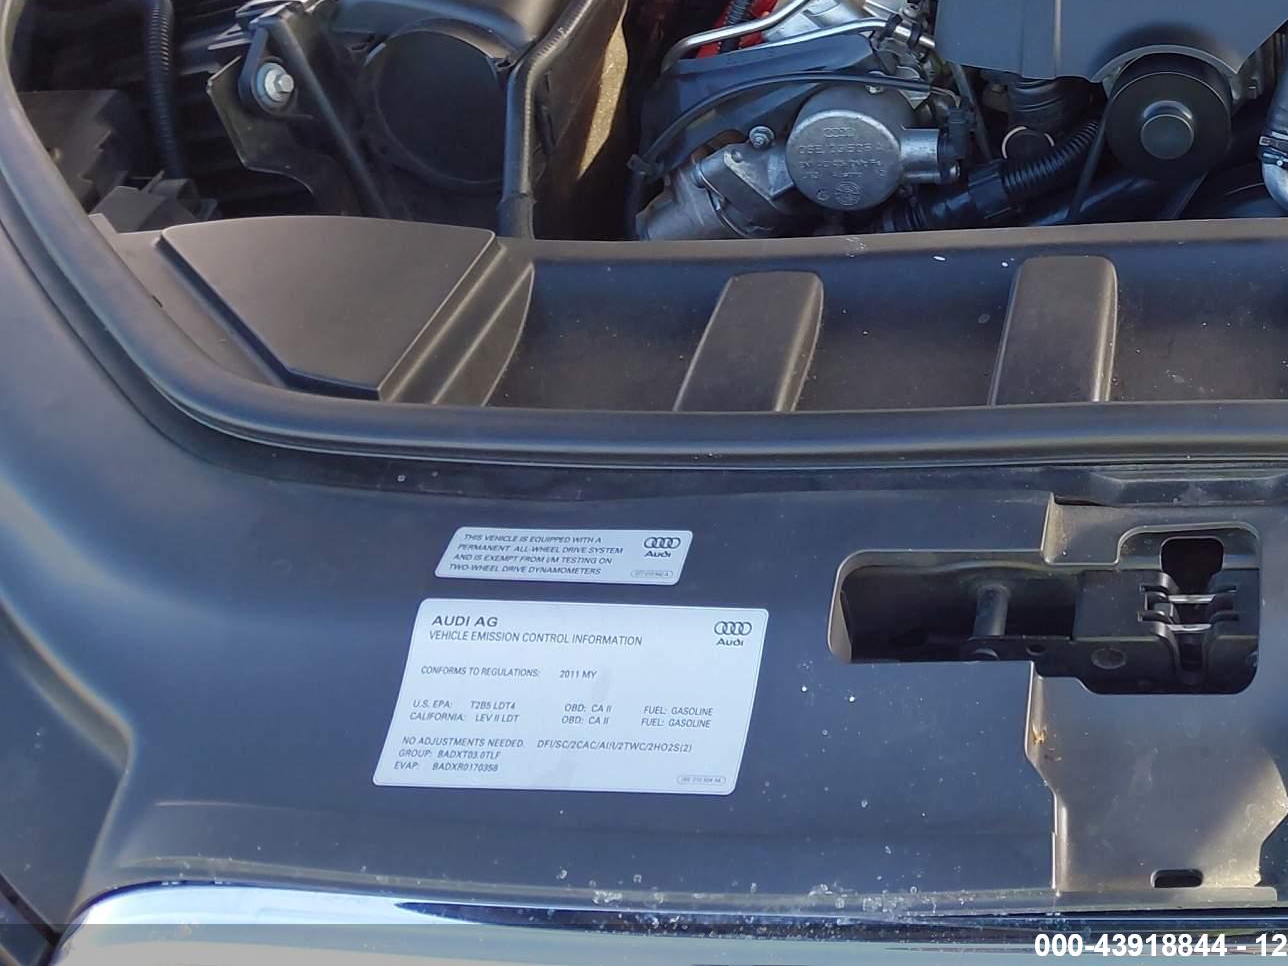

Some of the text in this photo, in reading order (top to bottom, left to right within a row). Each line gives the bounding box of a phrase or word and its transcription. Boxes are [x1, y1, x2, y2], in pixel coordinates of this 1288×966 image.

[485, 534, 517, 542] VEHICLE
[458, 544, 510, 552] PERMANENT
[528, 566, 601, 574] DYNAMOMETERS
[432, 616, 498, 626] AUDI AG
[430, 631, 642, 645] VEHICLE EMISSION CONTROL INFORMATION
[421, 666, 466, 675] CONFORMS
[560, 670, 597, 679] 2011 MY
[493, 702, 516, 710] LDT4
[564, 704, 586, 712] OBD:
[643, 706, 713, 715] FUEL: GASOLINE
[475, 714, 493, 722] LEV
[561, 716, 584, 724] OBD:
[641, 718, 711, 727] FUEL: GASOLINE
[419, 737, 485, 747] ADJUSTMENTS
